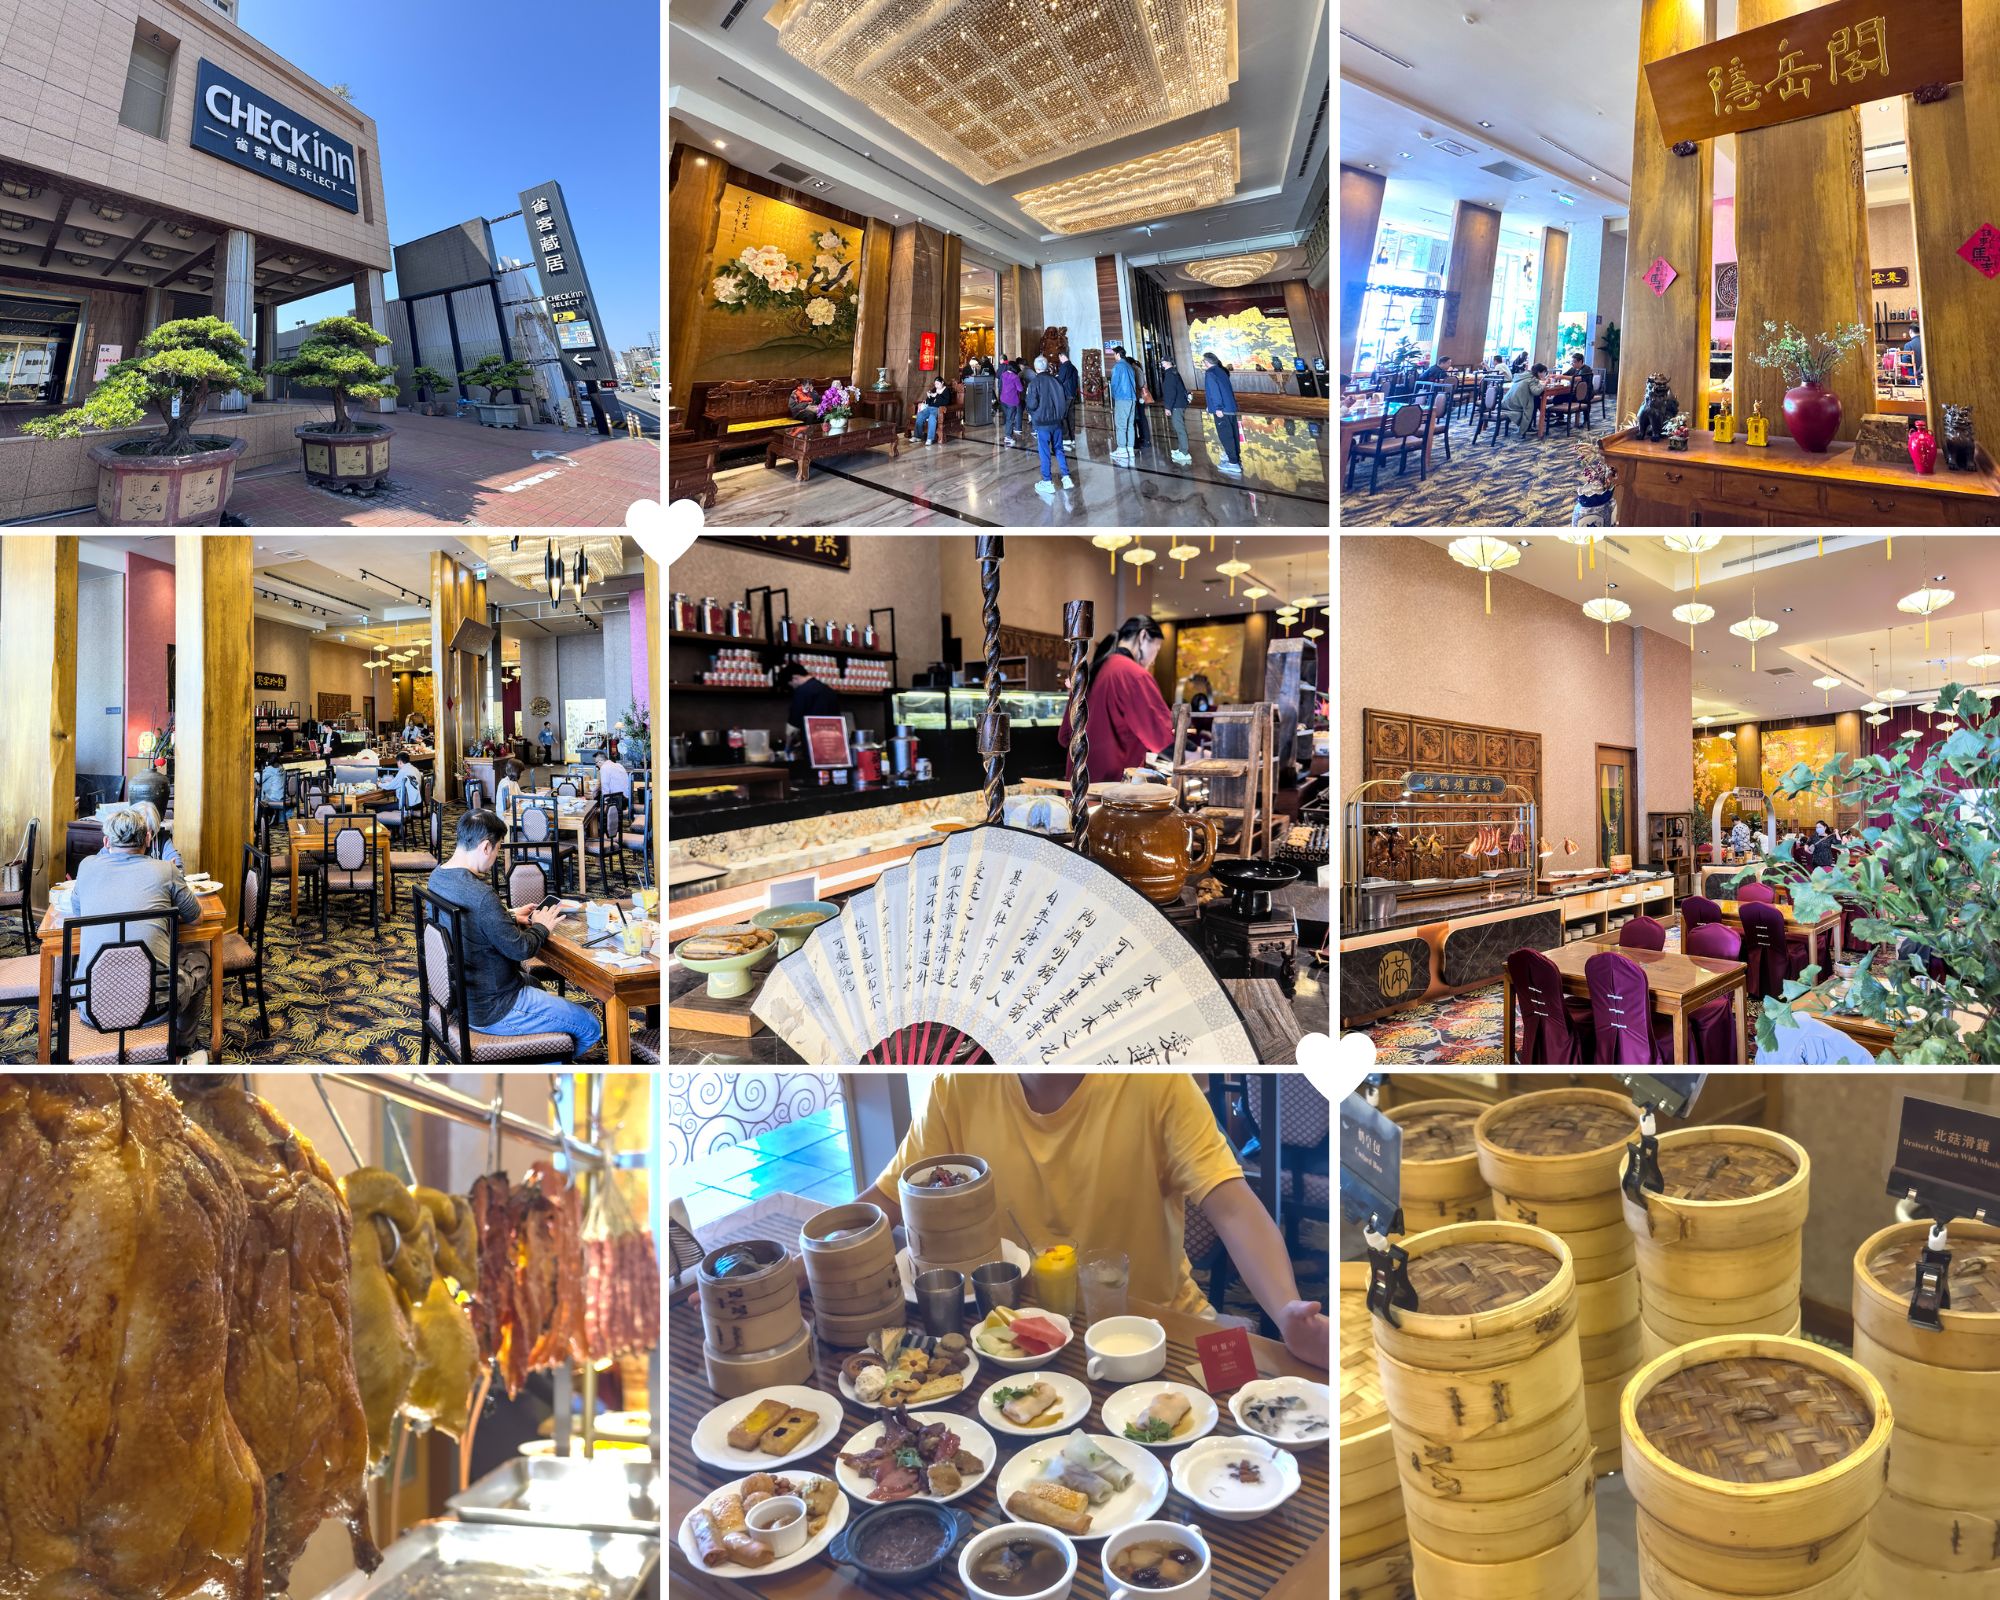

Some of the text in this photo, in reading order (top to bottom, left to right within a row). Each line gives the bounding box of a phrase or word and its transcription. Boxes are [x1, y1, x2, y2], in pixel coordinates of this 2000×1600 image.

[1707, 16, 1890, 117] 隱岳閣
[299, 167, 338, 191] SELECT
[531, 197, 564, 273] 雀客藏居
[551, 299, 581, 308] SELECT
[1934, 1128, 1990, 1153] 北菇滑雞
[1930, 1144, 1959, 1159] Chicken
[1961, 1152, 1978, 1163] With
